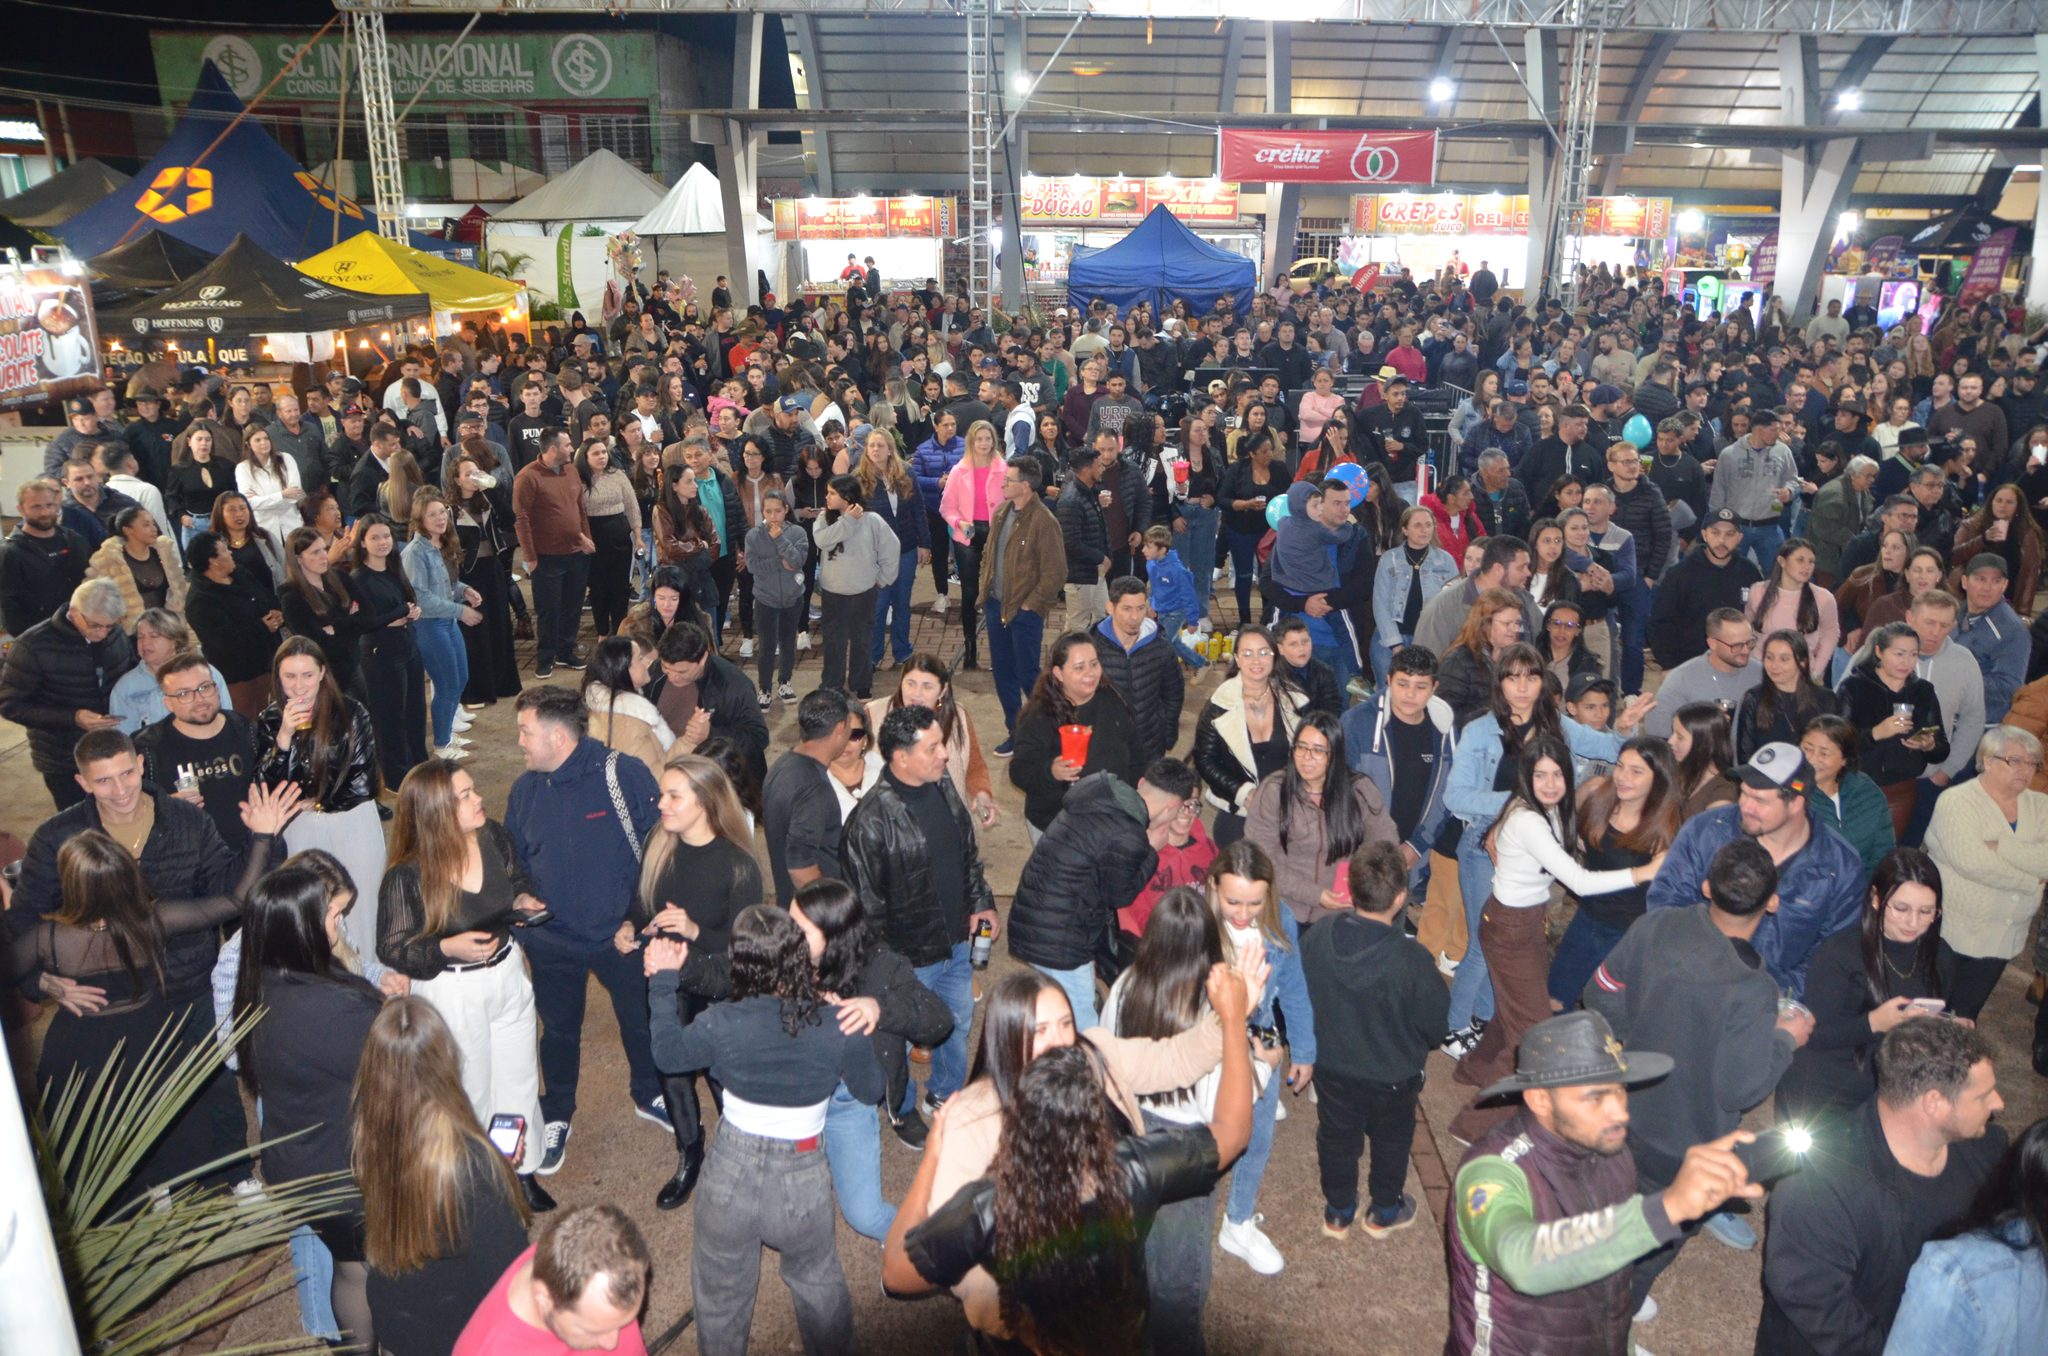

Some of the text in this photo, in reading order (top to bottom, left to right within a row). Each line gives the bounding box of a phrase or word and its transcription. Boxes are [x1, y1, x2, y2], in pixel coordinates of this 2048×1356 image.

[277, 42, 534, 77] SC INTRNACIONAL
[1255, 143, 1321, 163] creluz
[1108, 183, 1141, 192] XIS
[1380, 202, 1464, 222] CREPES
[1474, 212, 1504, 225] REI
[562, 239, 573, 287] Sicredi
[152, 318, 204, 329] HOFFNUNG
[218, 348, 248, 363] QUE
[197, 763, 228, 777] BOSS
